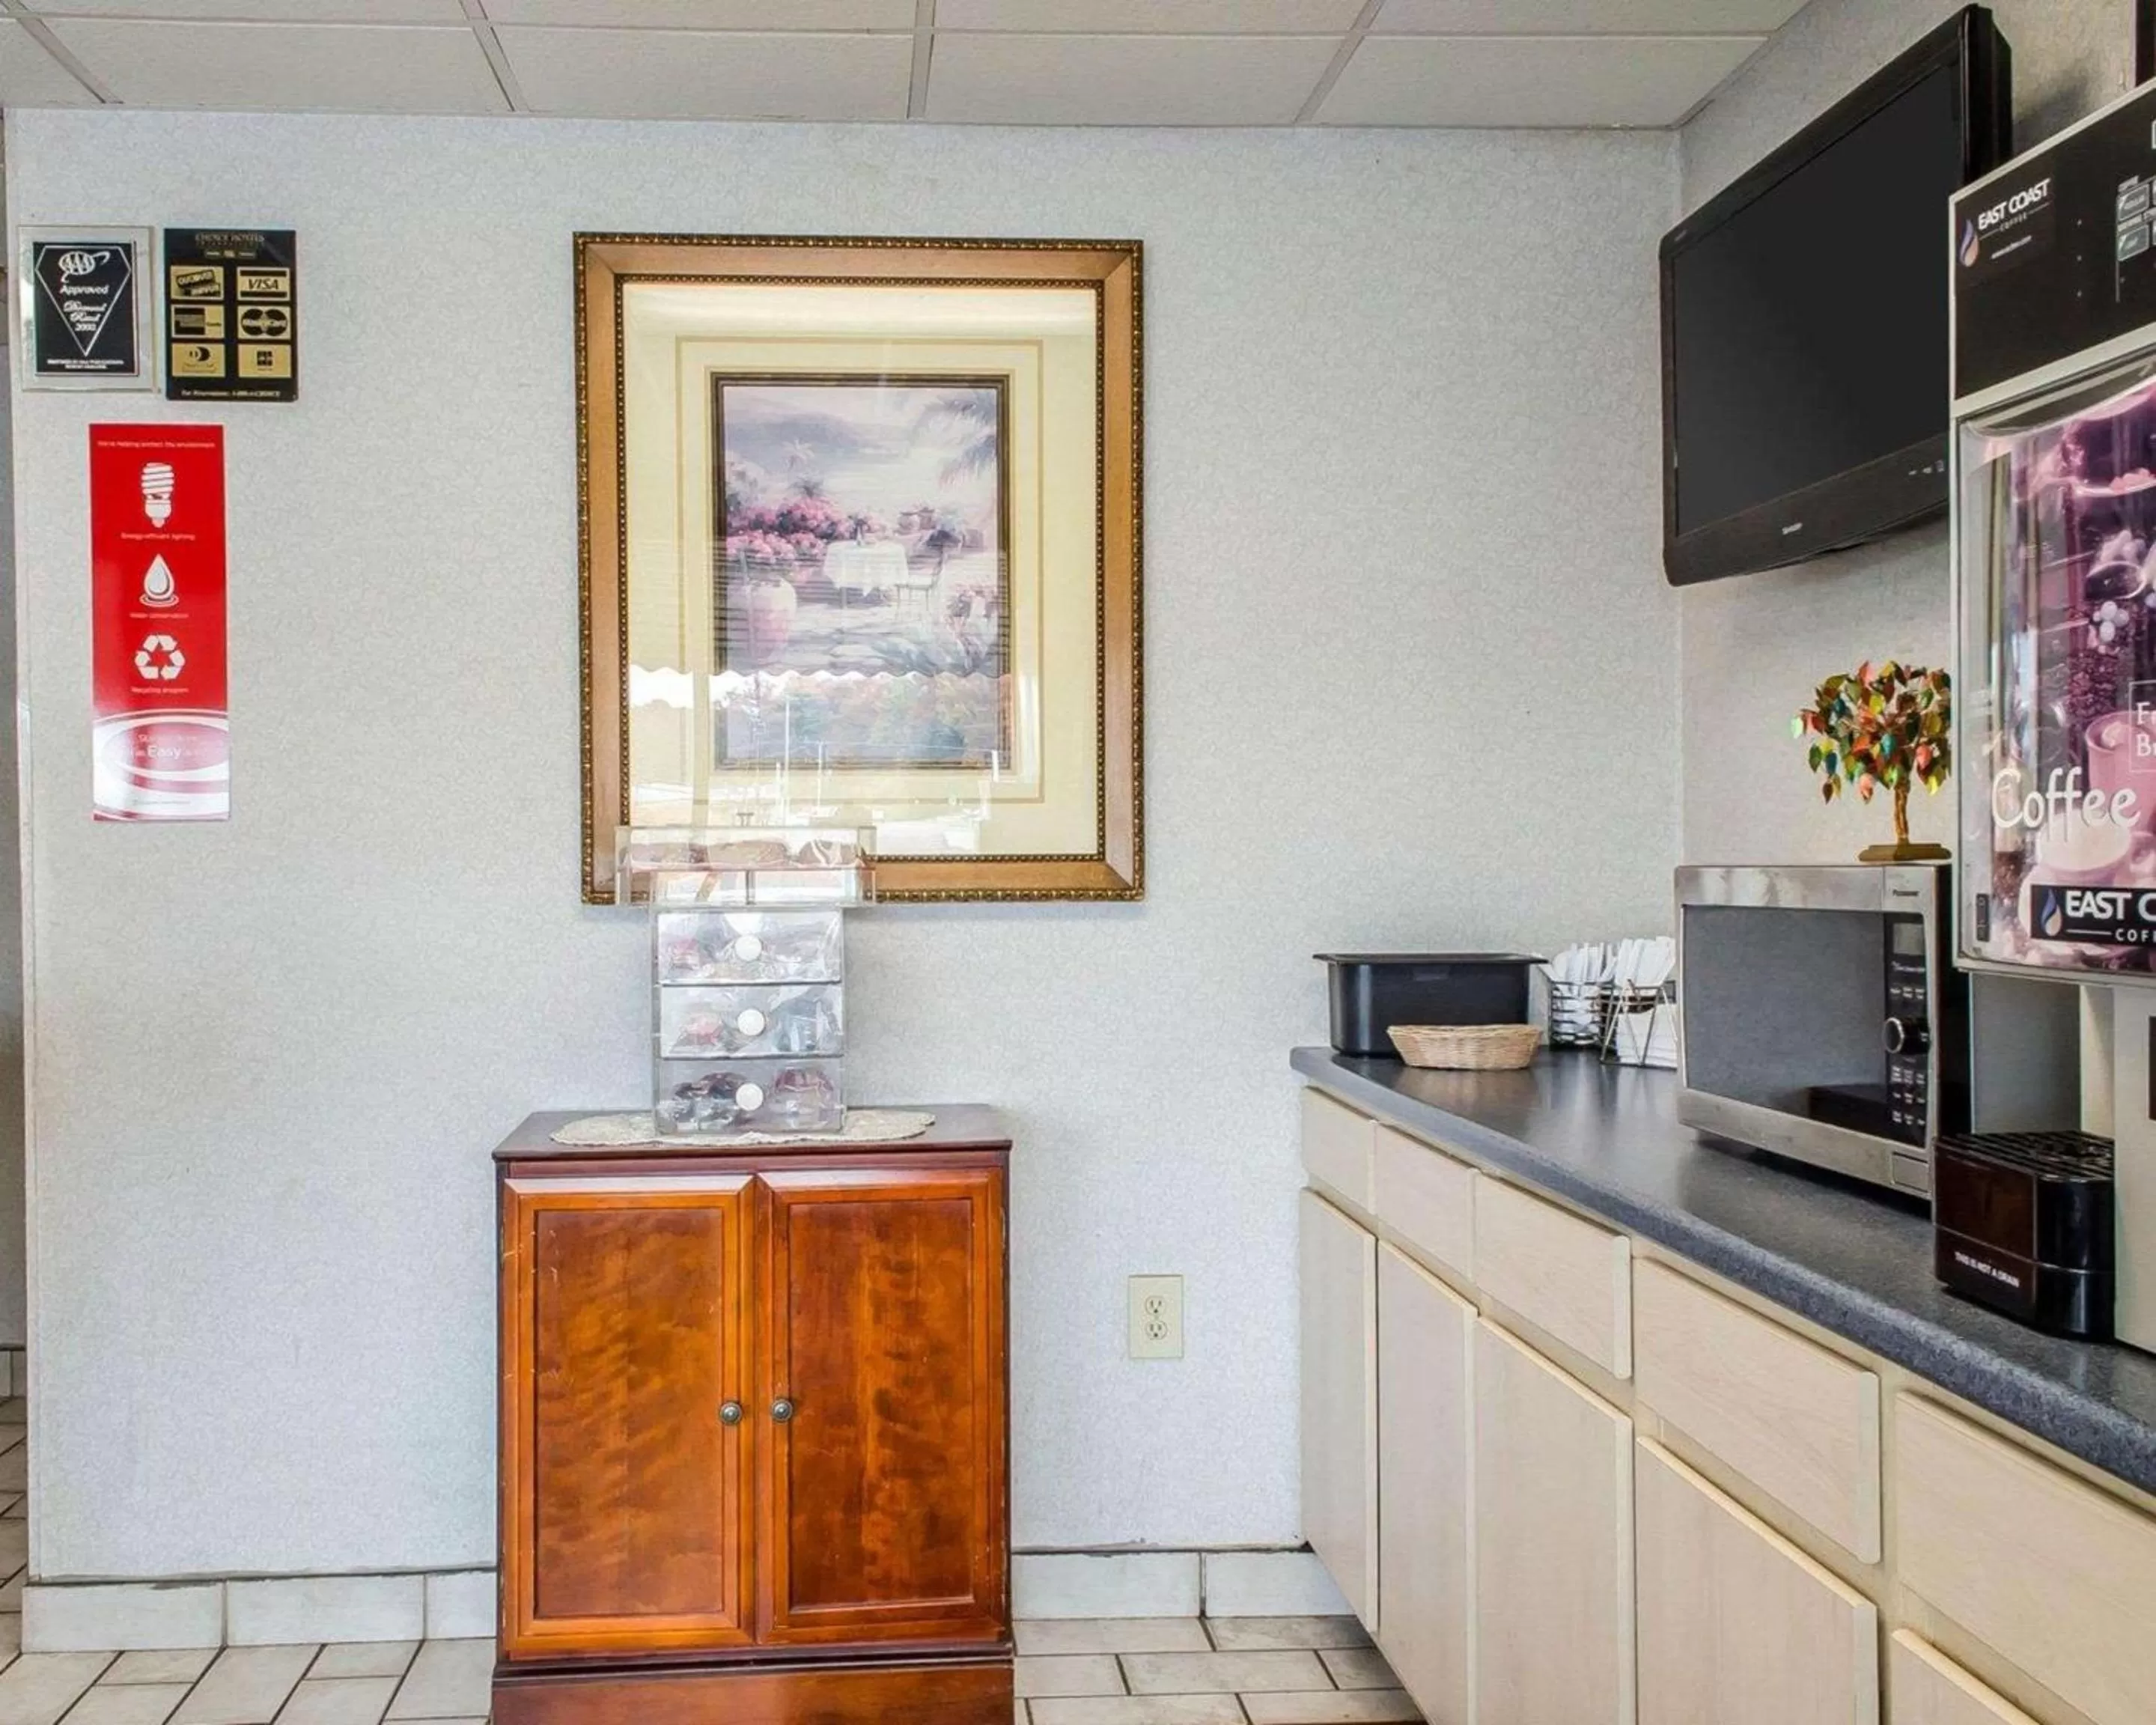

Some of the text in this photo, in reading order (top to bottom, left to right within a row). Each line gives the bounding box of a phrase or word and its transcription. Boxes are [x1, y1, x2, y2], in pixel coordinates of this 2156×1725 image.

[1979, 178, 2051, 230] EAST COAST
[59, 285, 110, 295] Approved
[248, 279, 279, 290] VISA
[1991, 766, 2141, 843] Coffee
[2066, 890, 2132, 921] EAST
